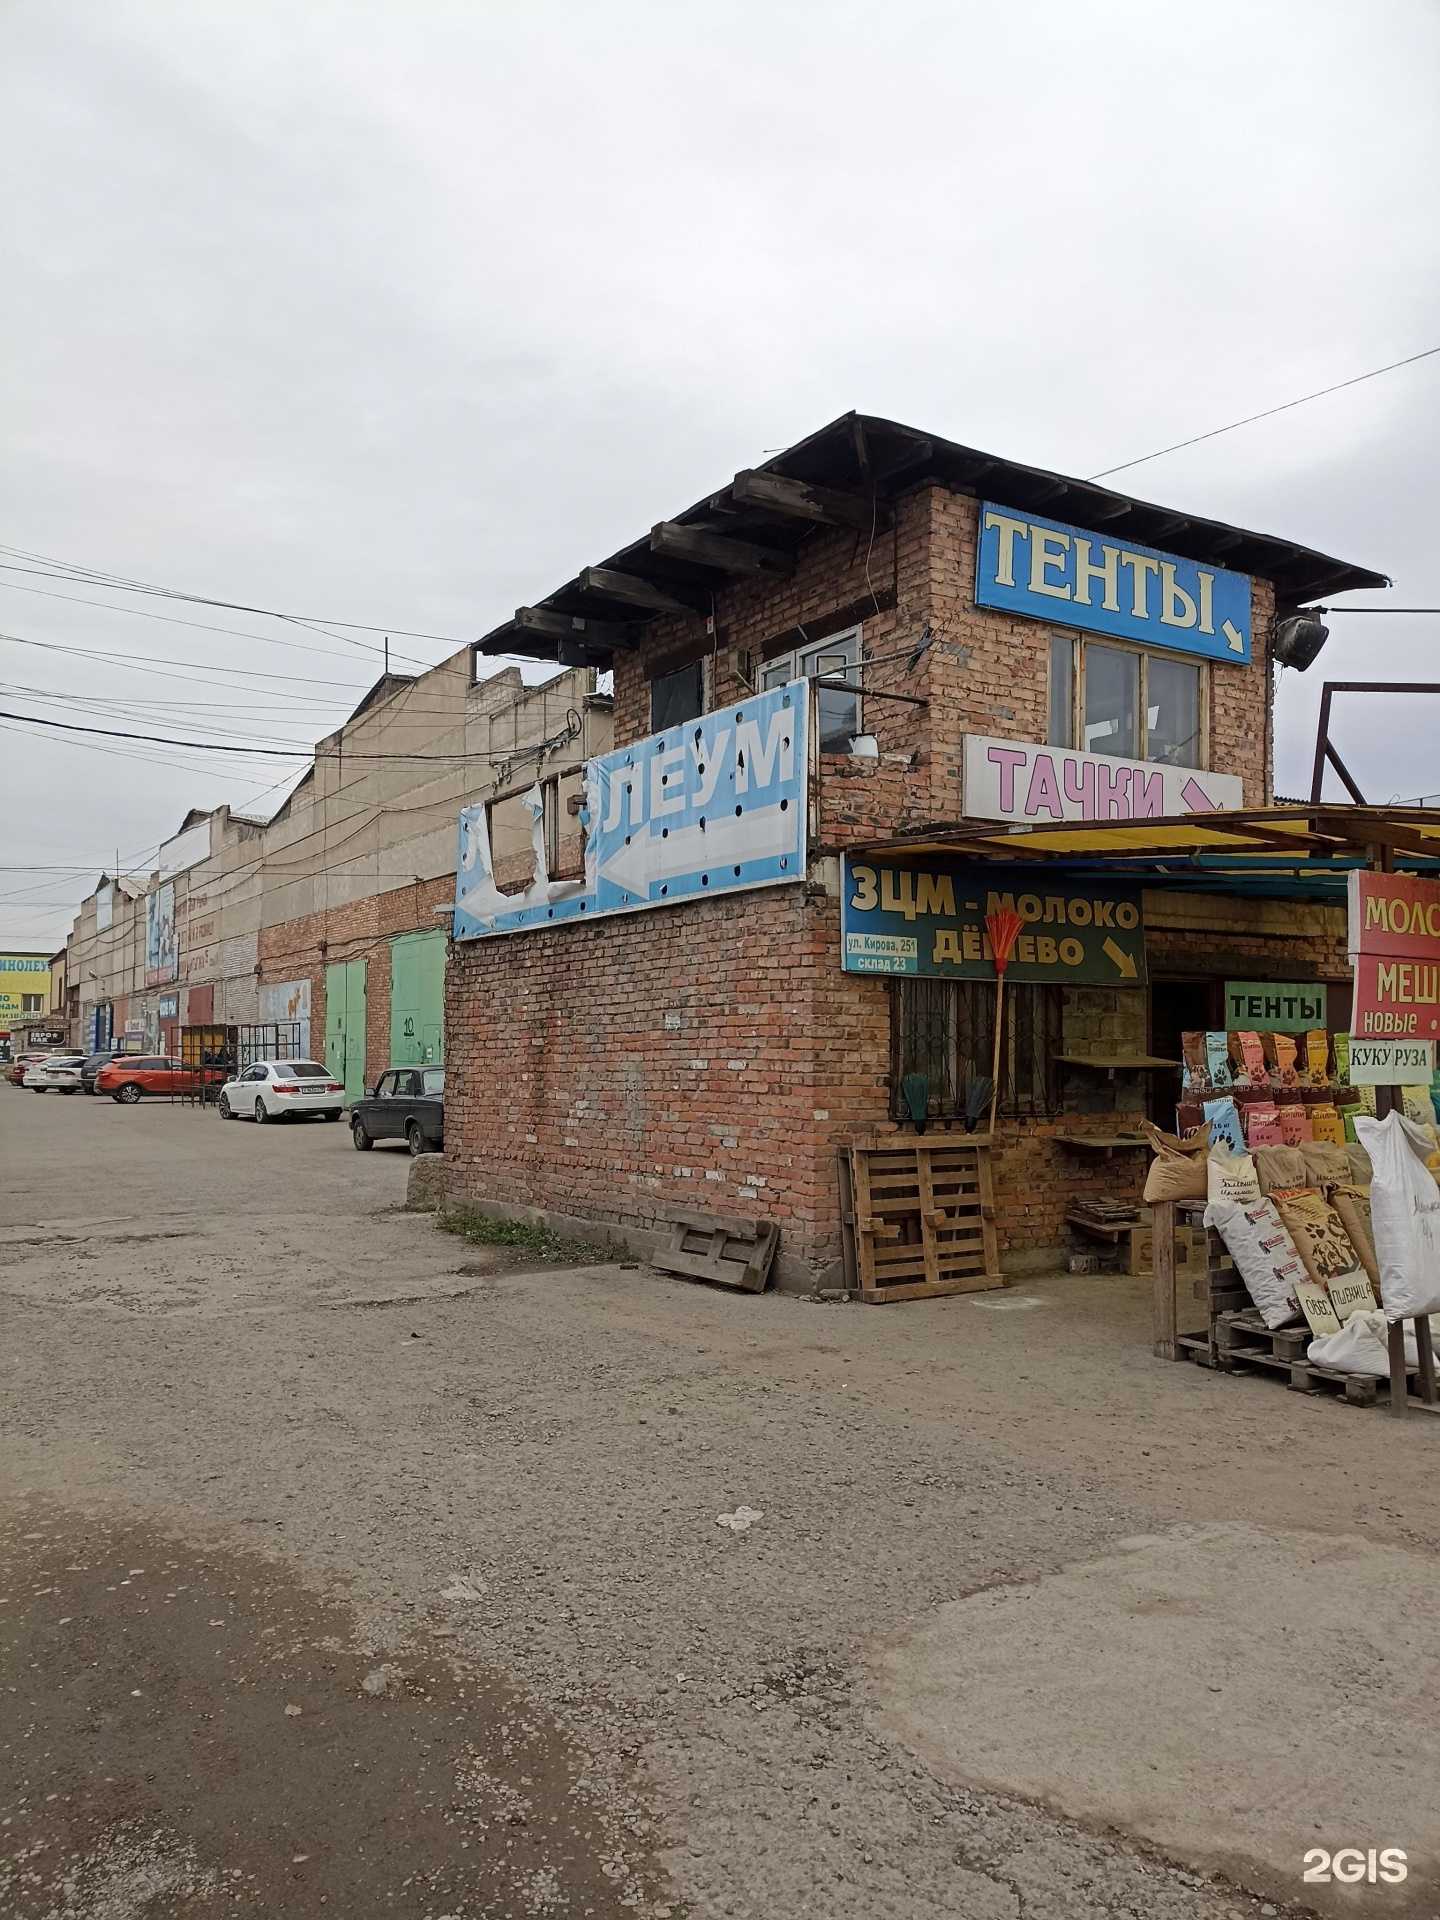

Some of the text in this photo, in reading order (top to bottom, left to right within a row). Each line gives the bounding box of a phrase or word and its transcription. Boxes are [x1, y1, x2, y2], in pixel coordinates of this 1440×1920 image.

[985, 511, 1215, 635] ТЕНТЫ
[988, 747, 1164, 822] ТАЧКИ
[850, 865, 957, 920] ЗЦМ
[985, 891, 1139, 930] МОЛОКО
[848, 937, 916, 953] ул. Кирова, 251
[932, 924, 1086, 967] ДЁЕВО
[0, 960, 51, 973] ИНОЛЕУ
[858, 957, 906, 972] склад 23
[1377, 962, 1440, 1004] МЕШ
[1230, 995, 1322, 1020] ТЕНТЫ
[403, 1016, 414, 1032] 10
[1332, 1281, 1373, 1306] ПШЕНИЦА
